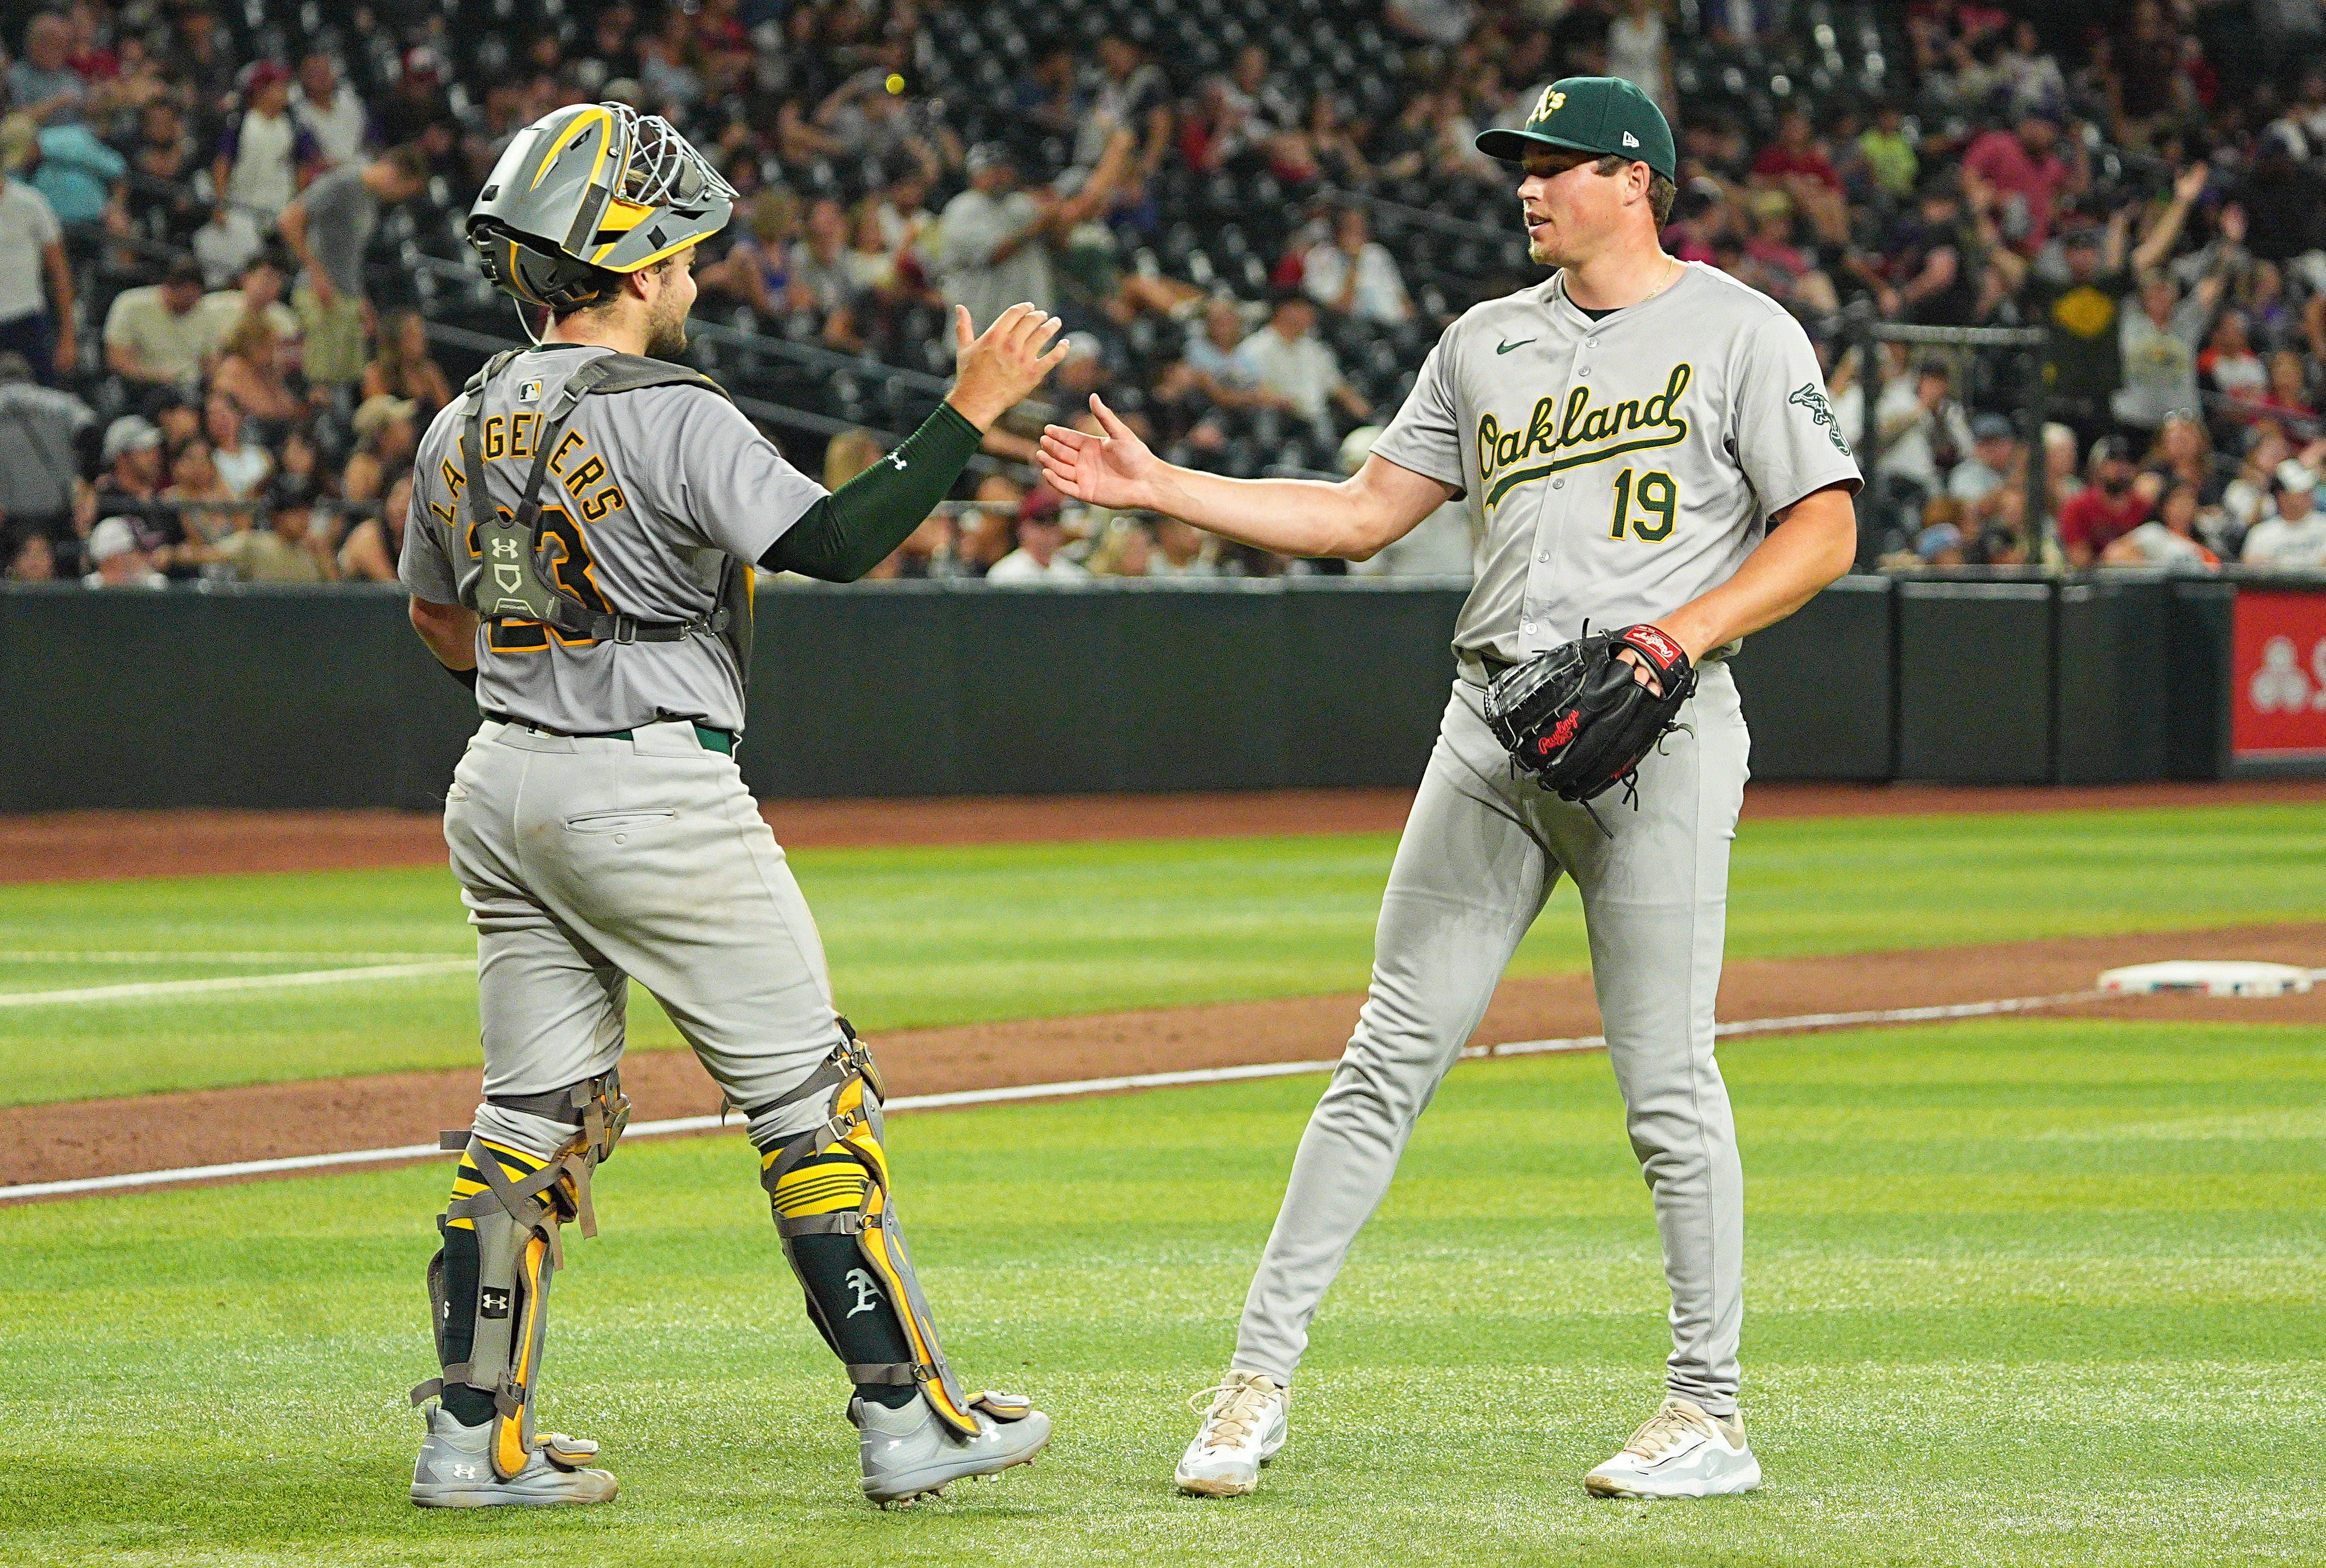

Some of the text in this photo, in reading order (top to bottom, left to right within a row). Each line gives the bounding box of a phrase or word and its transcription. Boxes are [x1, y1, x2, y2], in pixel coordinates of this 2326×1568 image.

[1477, 362, 1692, 481] Oakland
[1609, 466, 1679, 544] 19
[1538, 709, 1580, 755] Rawlings
